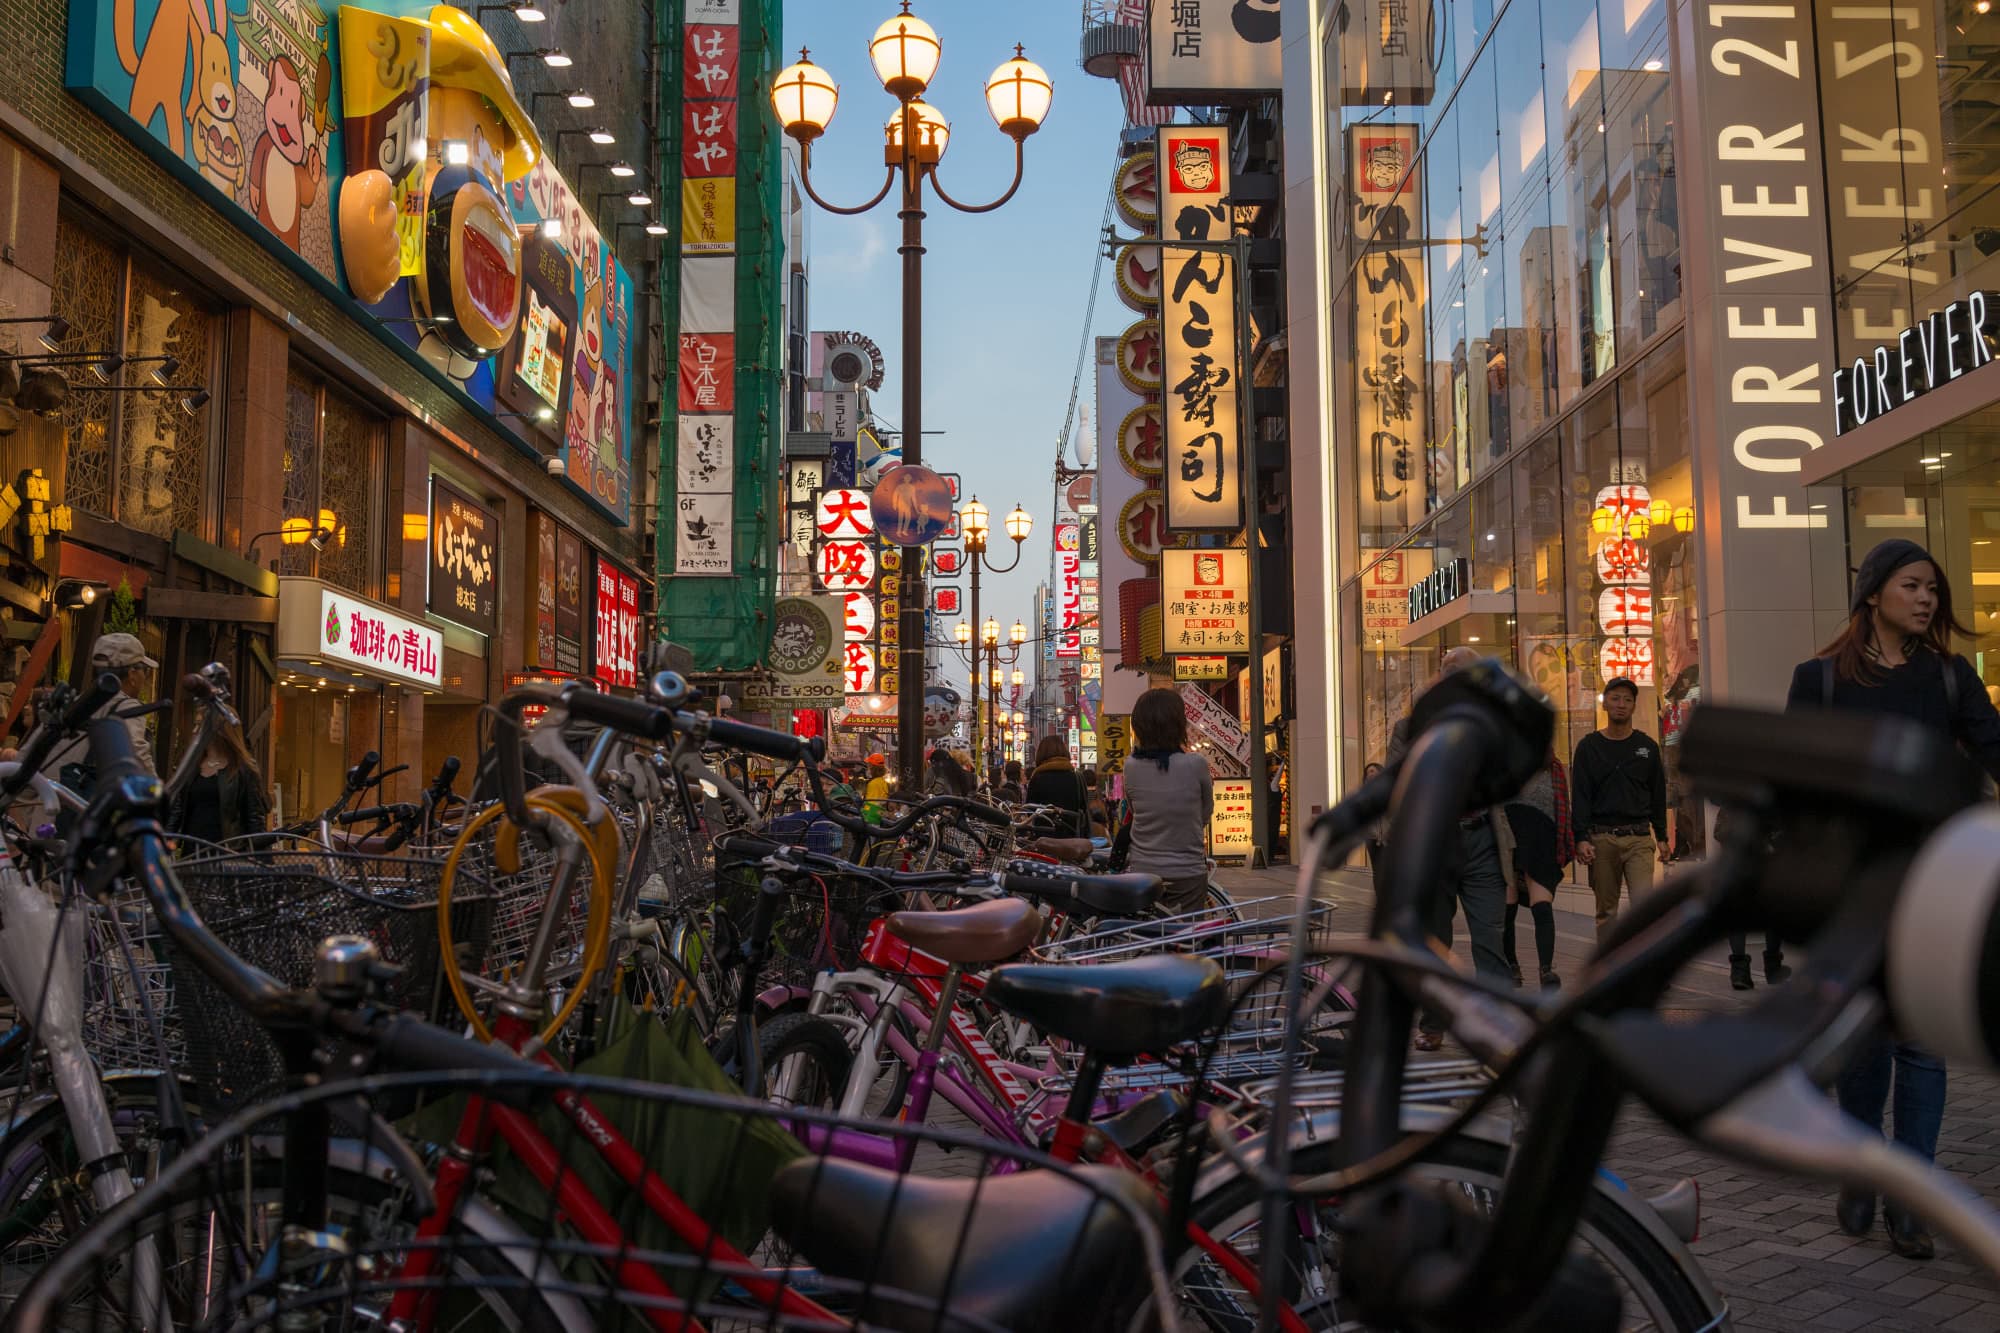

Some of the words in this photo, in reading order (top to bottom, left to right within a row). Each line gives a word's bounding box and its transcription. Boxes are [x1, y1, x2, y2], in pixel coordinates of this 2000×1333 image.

[693, 29, 730, 93] はや
[1708, 4, 1801, 80] 21
[691, 105, 728, 172] はや
[681, 337, 698, 349] 2F
[1718, 123, 1828, 529] FOREVER
[693, 341, 720, 406] 白木屋
[1832, 290, 1992, 438] FOREVER
[680, 499, 696, 511] 6F
[1408, 566, 1446, 626] FOREVER
[1448, 560, 1460, 601] 21
[350, 611, 437, 679] 珈琲の青山
[825, 660, 842, 674] 2F
[1178, 629, 1246, 646] 寿司・和食
[746, 685, 792, 697] CAFE
